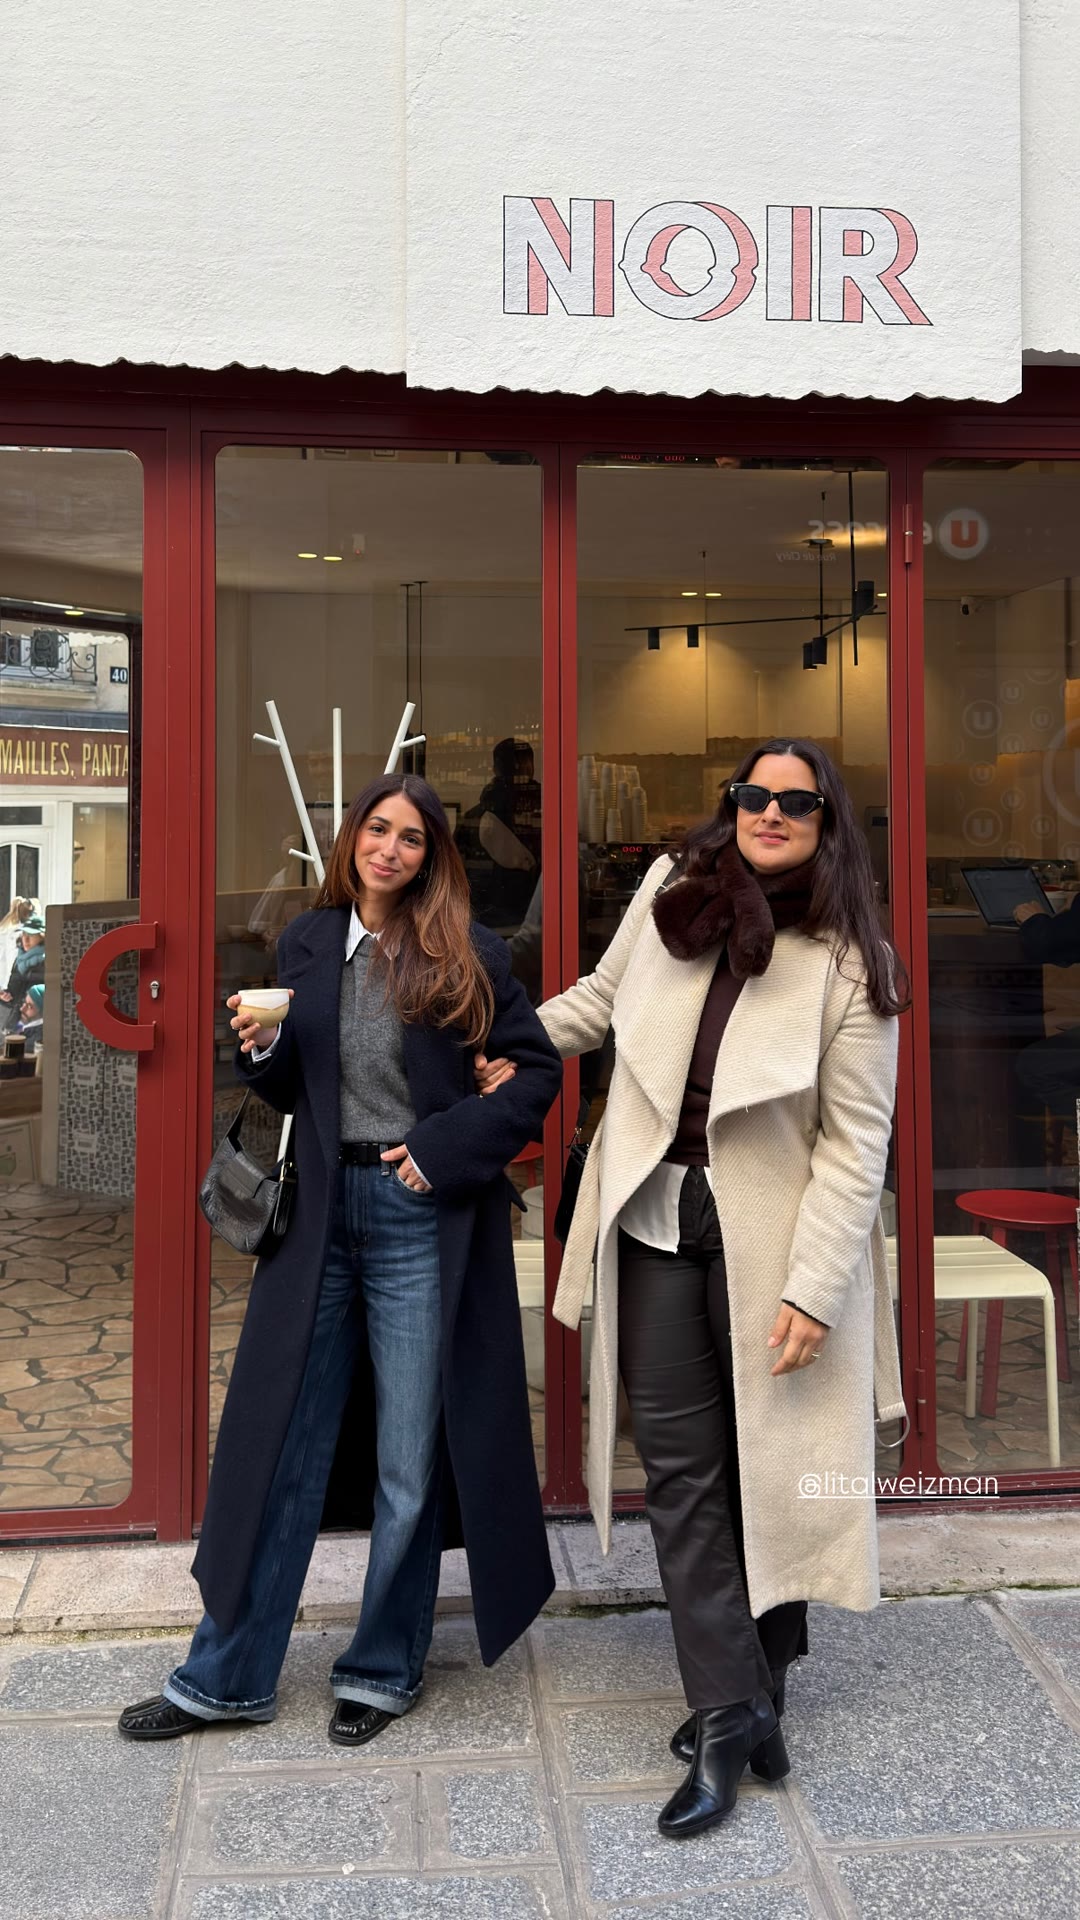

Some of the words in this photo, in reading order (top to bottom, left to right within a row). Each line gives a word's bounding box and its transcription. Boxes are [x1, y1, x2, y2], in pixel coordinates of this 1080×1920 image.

[503, 195, 934, 326] NOIR
[111, 668, 128, 683] 40
[0, 738, 75, 777] MAILLES,
[82, 743, 128, 777] PANTA
